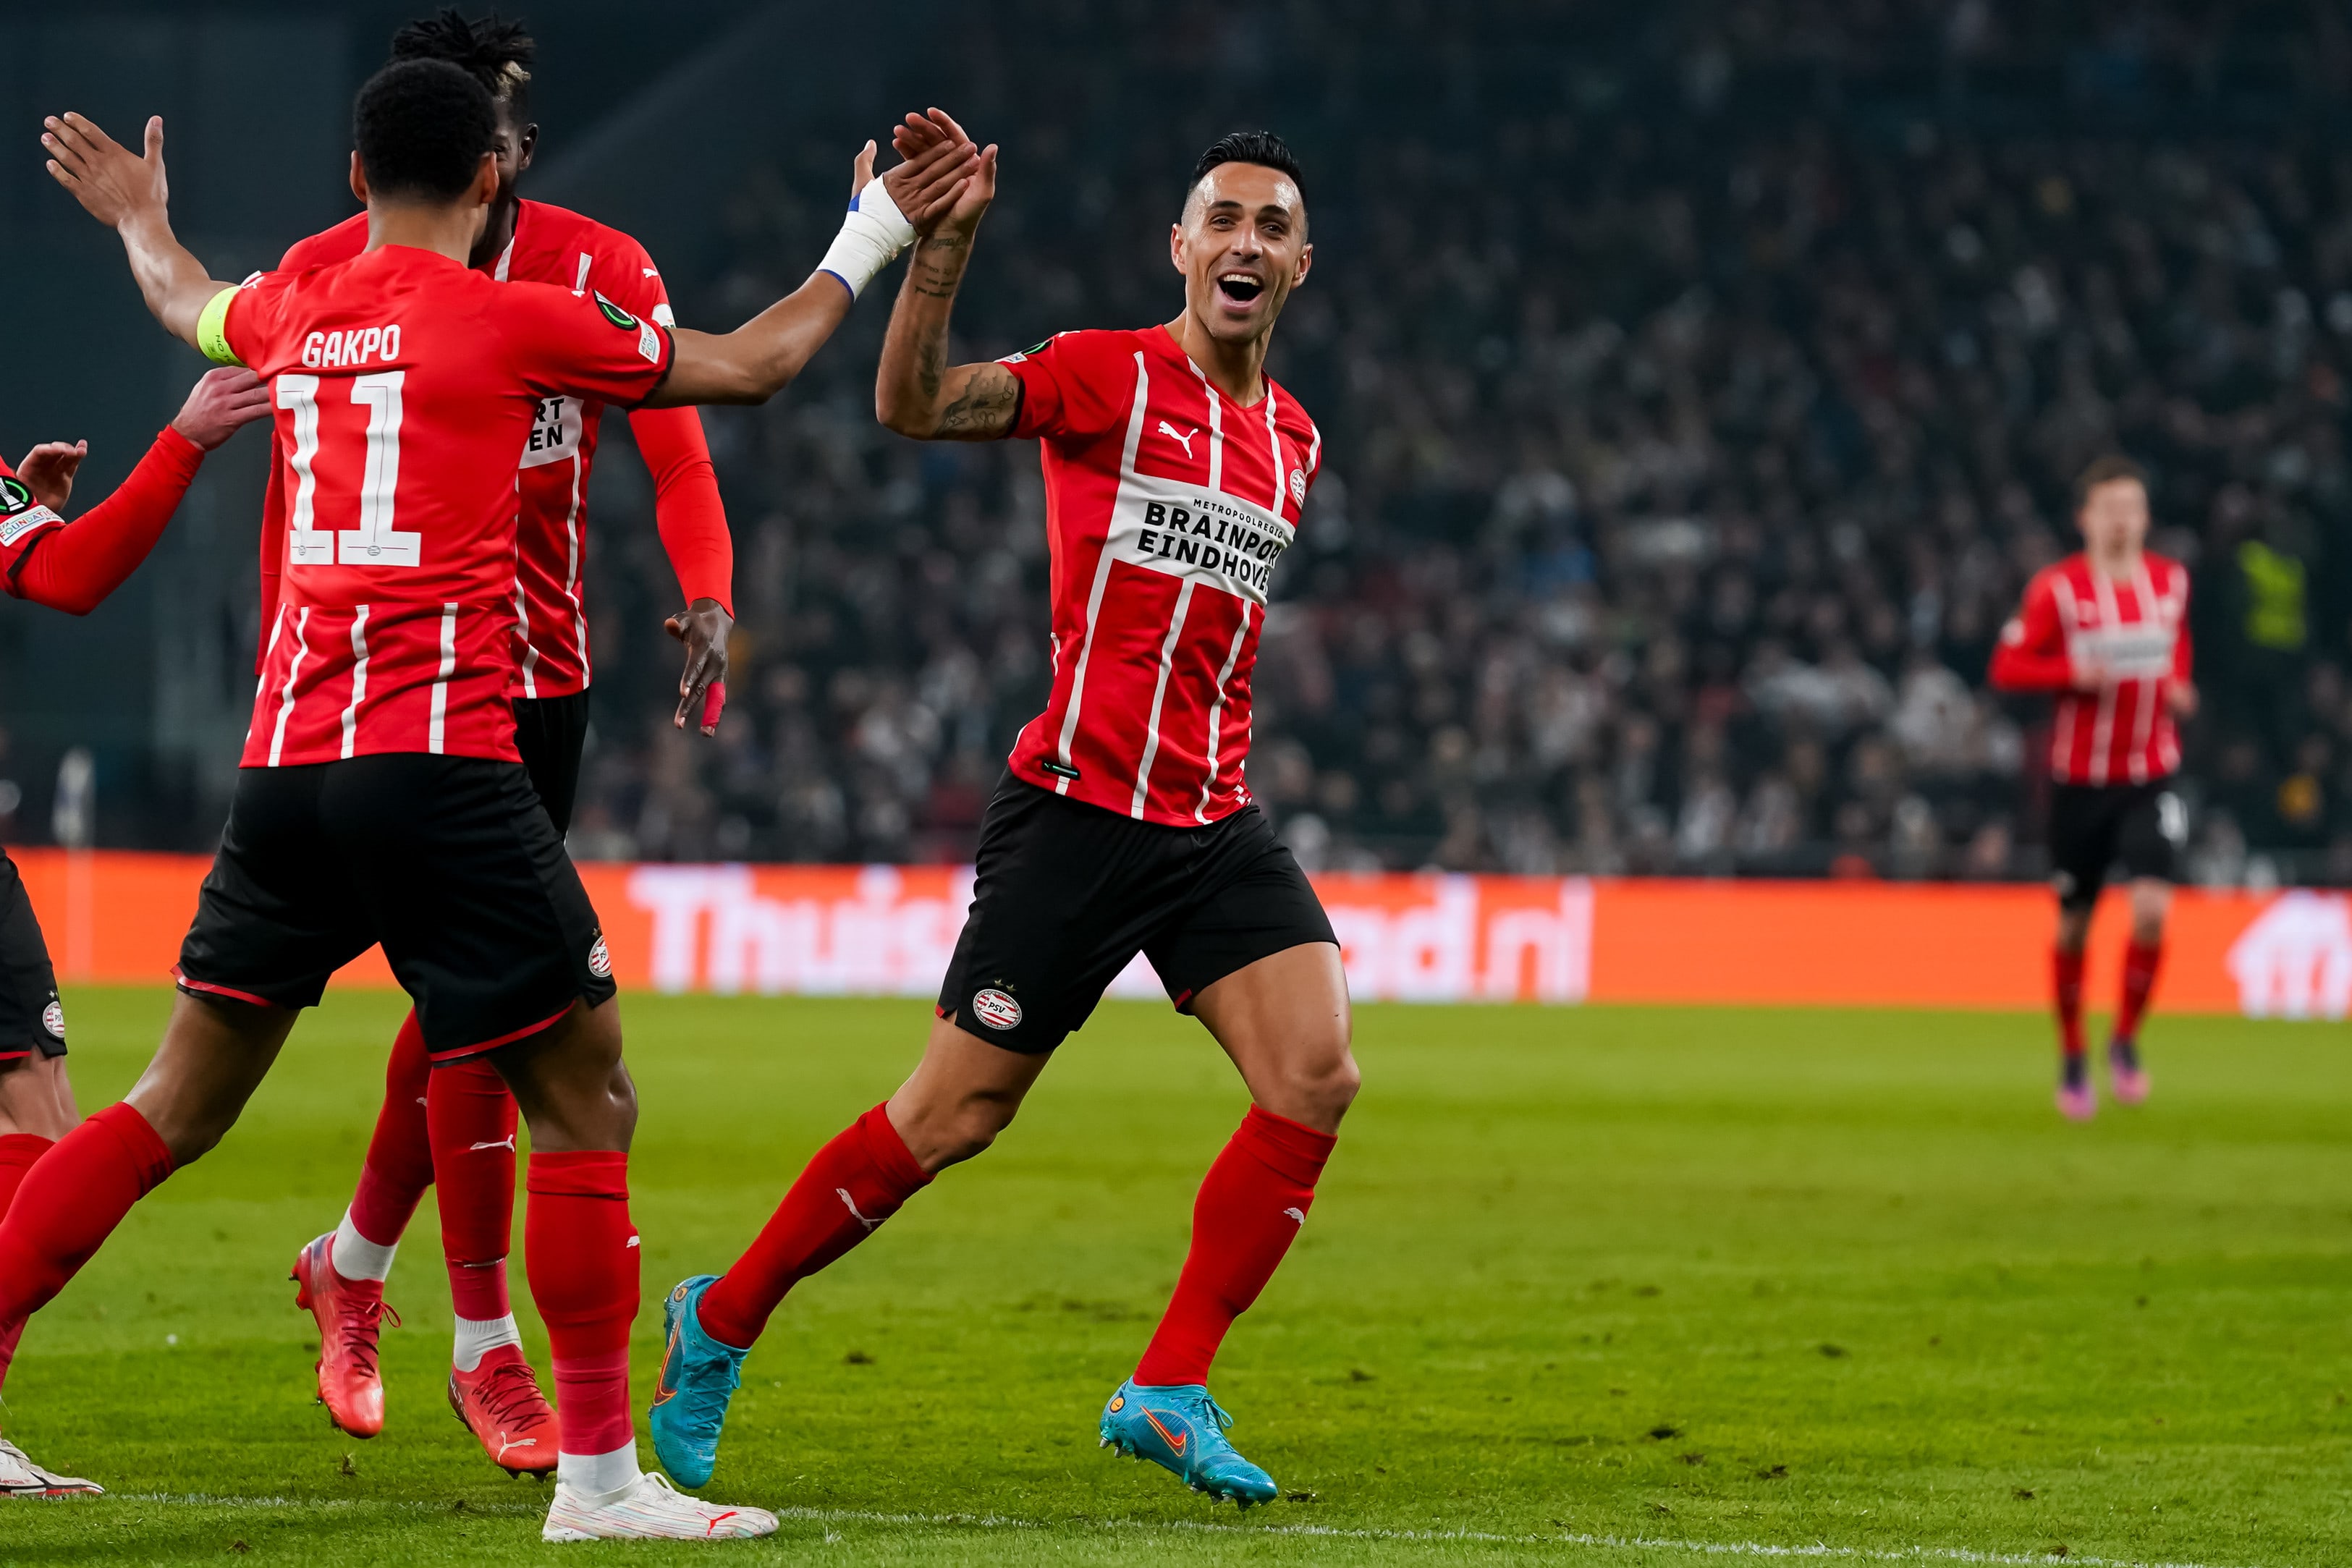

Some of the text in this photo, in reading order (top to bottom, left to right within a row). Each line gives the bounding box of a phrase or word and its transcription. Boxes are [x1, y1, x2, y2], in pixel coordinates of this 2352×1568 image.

[303, 324, 401, 368] GAKPO
[276, 370, 422, 567] 11
[1144, 501, 1281, 567] BRAINPOR
[1193, 498, 1284, 538] METROPOOLREGIO
[1137, 528, 1269, 593] EINDHOVE
[988, 1001, 1006, 1014] PSV
